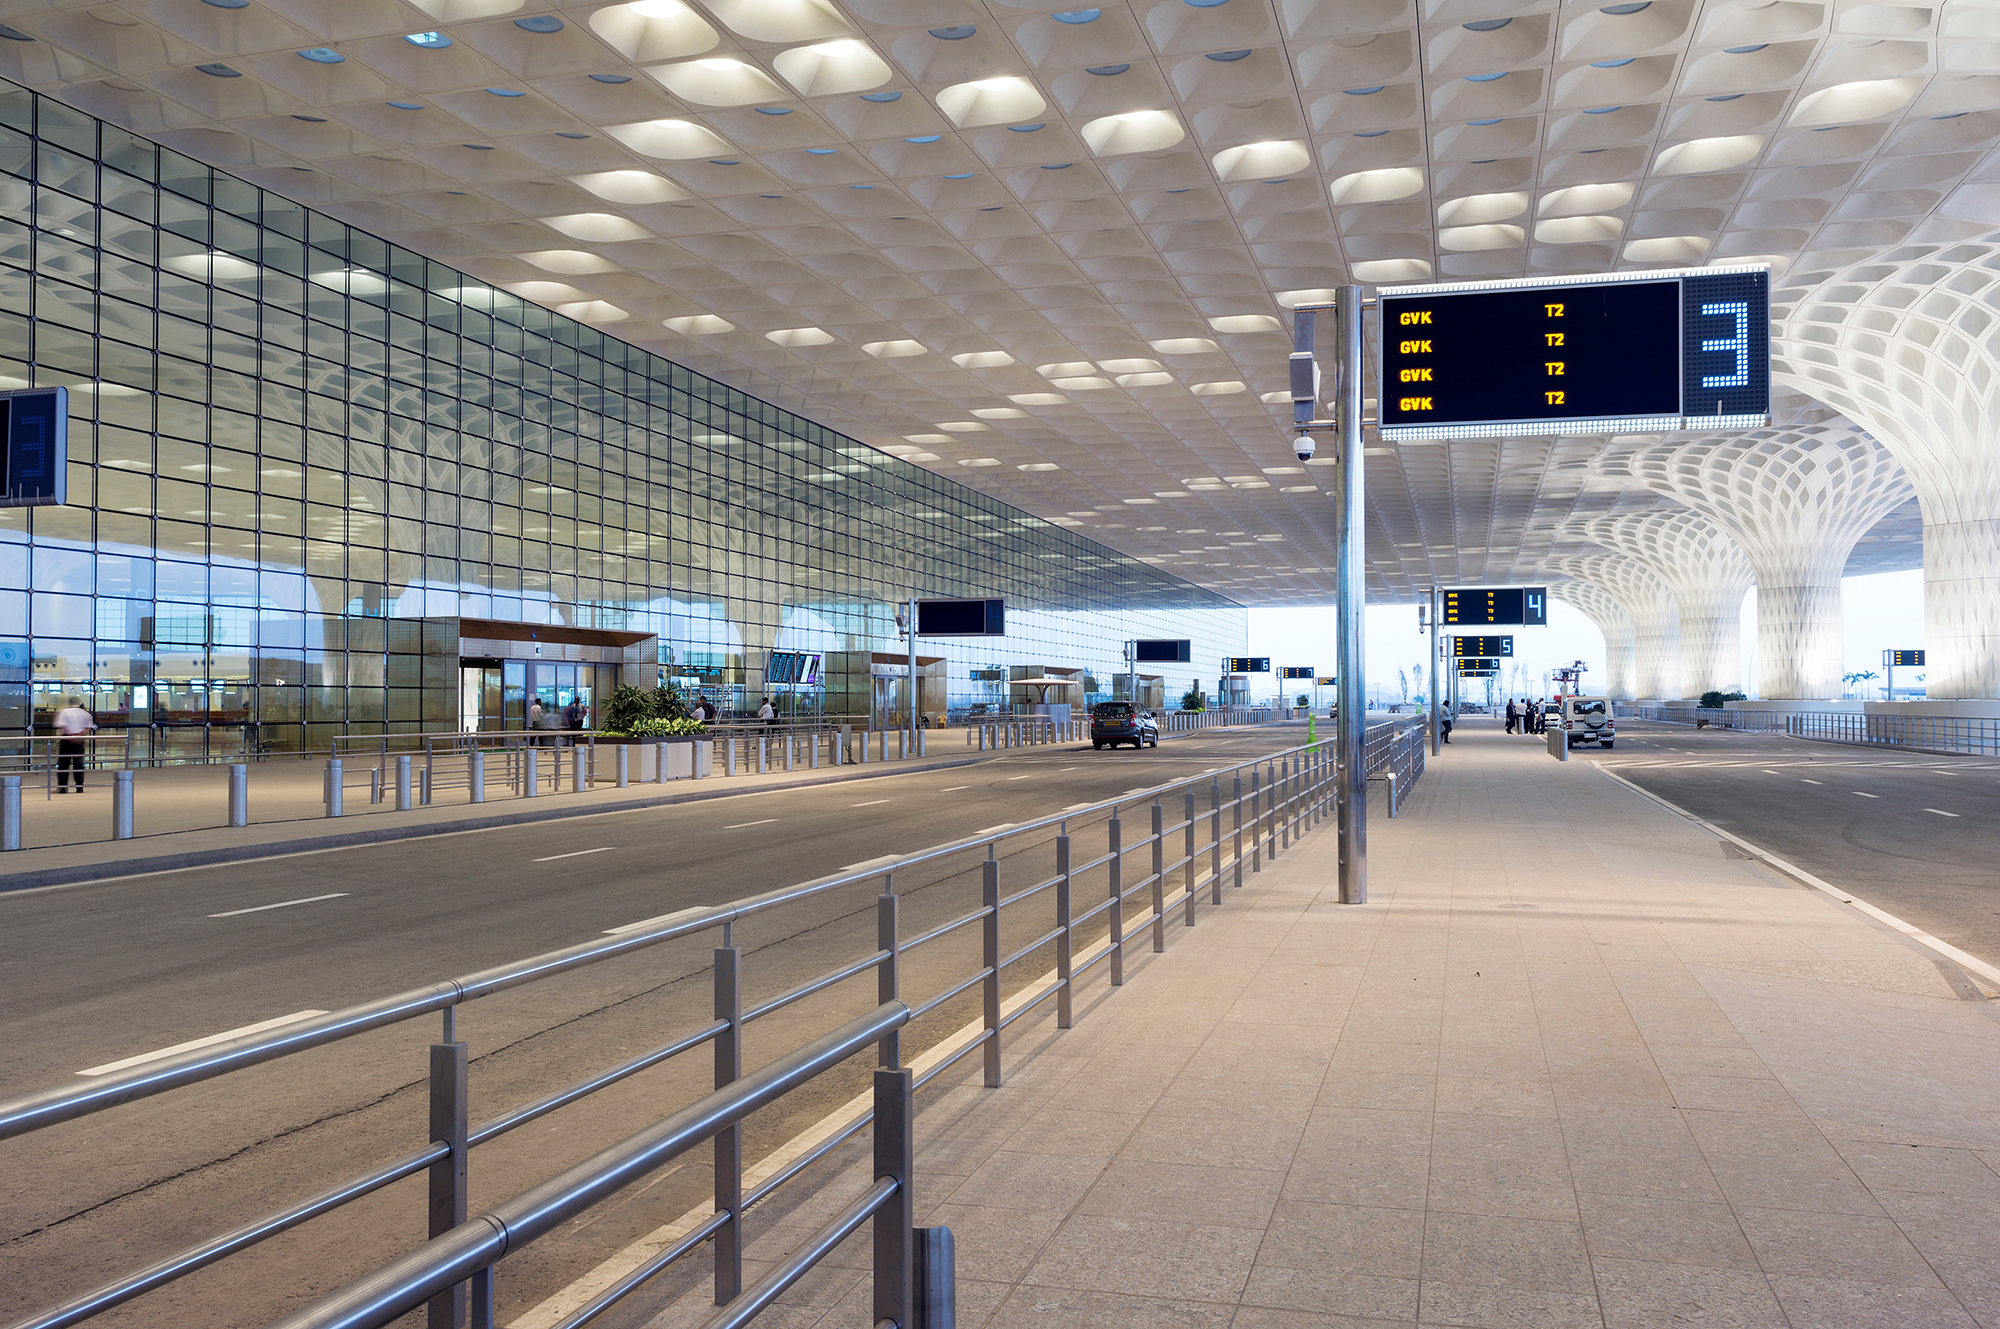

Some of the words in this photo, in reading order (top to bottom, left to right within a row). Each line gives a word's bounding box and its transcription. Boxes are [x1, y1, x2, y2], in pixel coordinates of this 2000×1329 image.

[1399, 311, 1433, 325] GVK
[1545, 304, 1565, 317] T2
[1399, 340, 1433, 353] GVK
[1545, 333, 1565, 346] T2
[1702, 302, 1748, 387] 3
[1399, 368, 1433, 382] GVK
[1545, 362, 1565, 375] T2
[1399, 397, 1433, 411] GVK
[1545, 391, 1565, 404] T2
[21, 416, 45, 477] 3
[1529, 595, 1542, 618] 4
[1503, 639, 1511, 653] 5
[1262, 660, 1268, 670] 6
